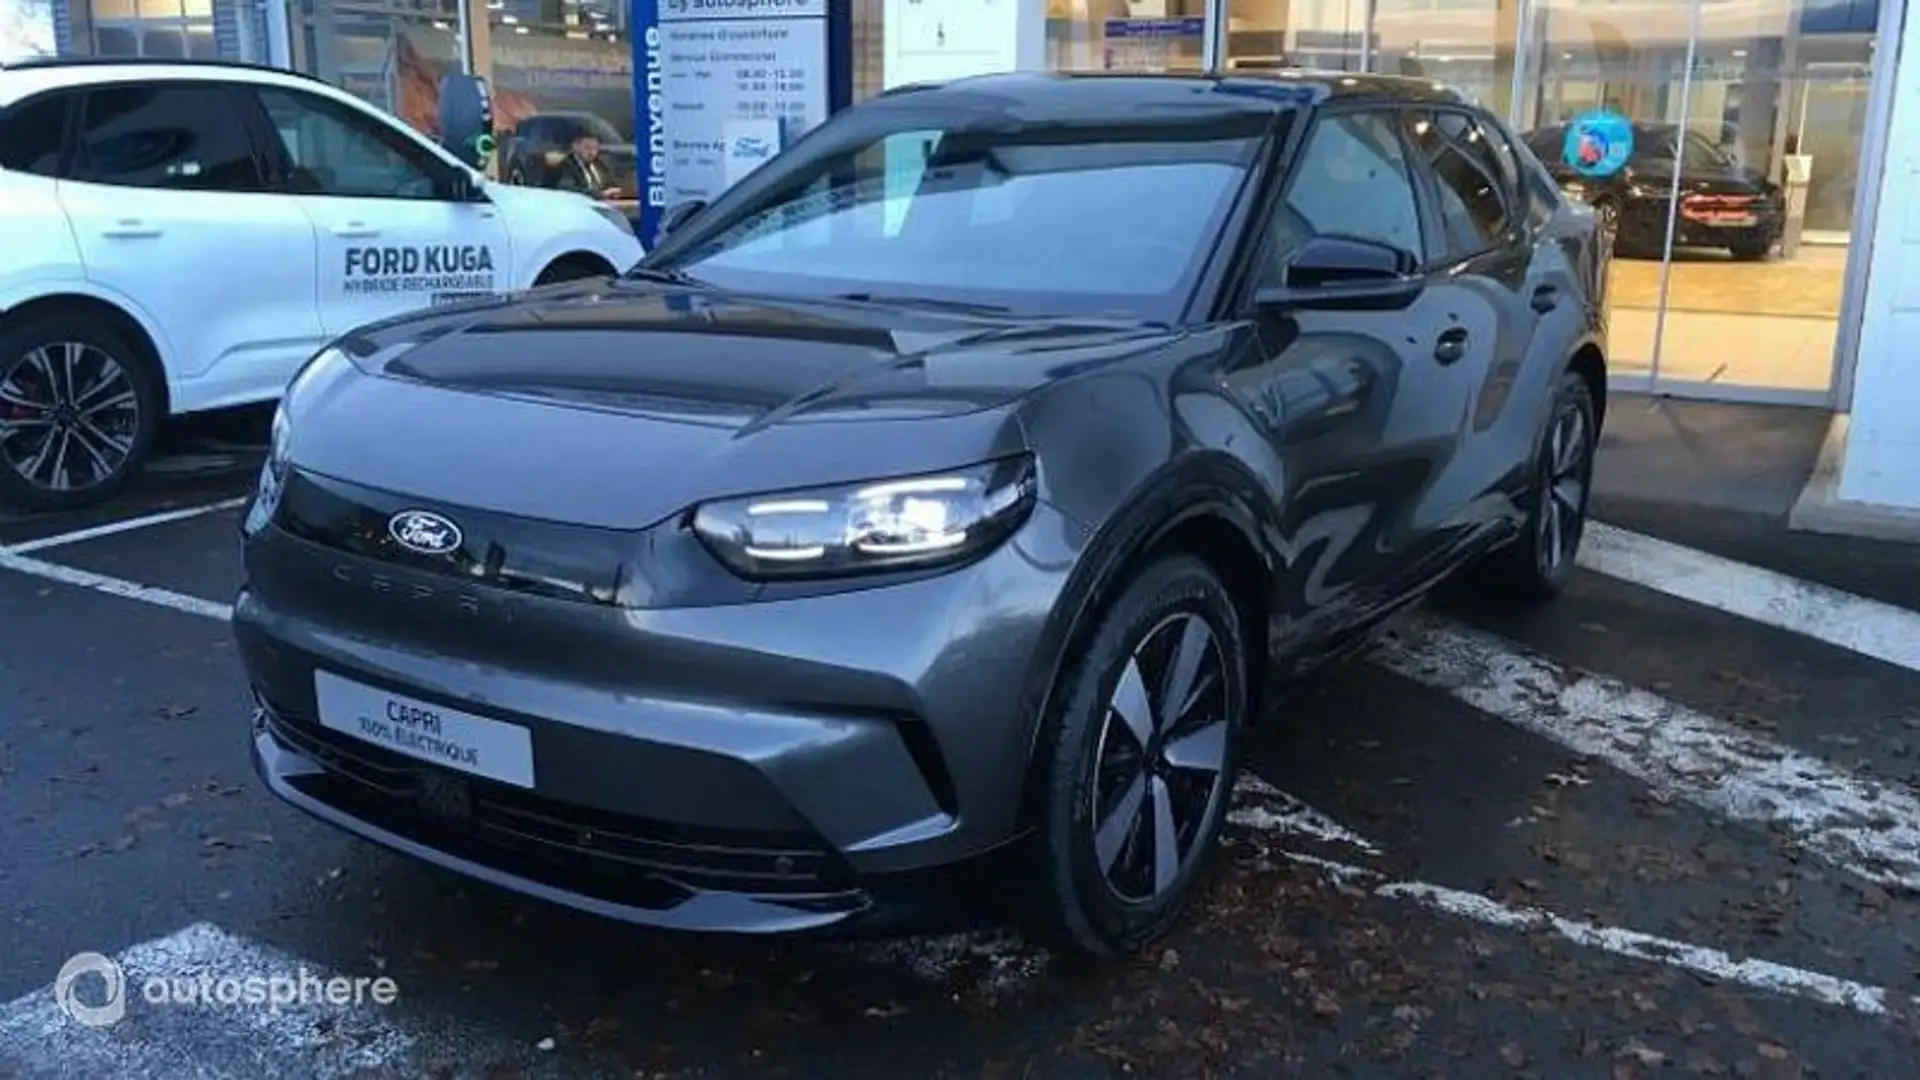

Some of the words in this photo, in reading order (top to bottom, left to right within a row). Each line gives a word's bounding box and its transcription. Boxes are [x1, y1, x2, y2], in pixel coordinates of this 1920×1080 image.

[645, 26, 665, 207] Bienvenue
[345, 247, 419, 275] FORD
[425, 245, 494, 273] KUGA
[343, 278, 401, 294] HYBRIDE
[401, 516, 448, 547] Ford
[386, 700, 442, 735] CAPRI
